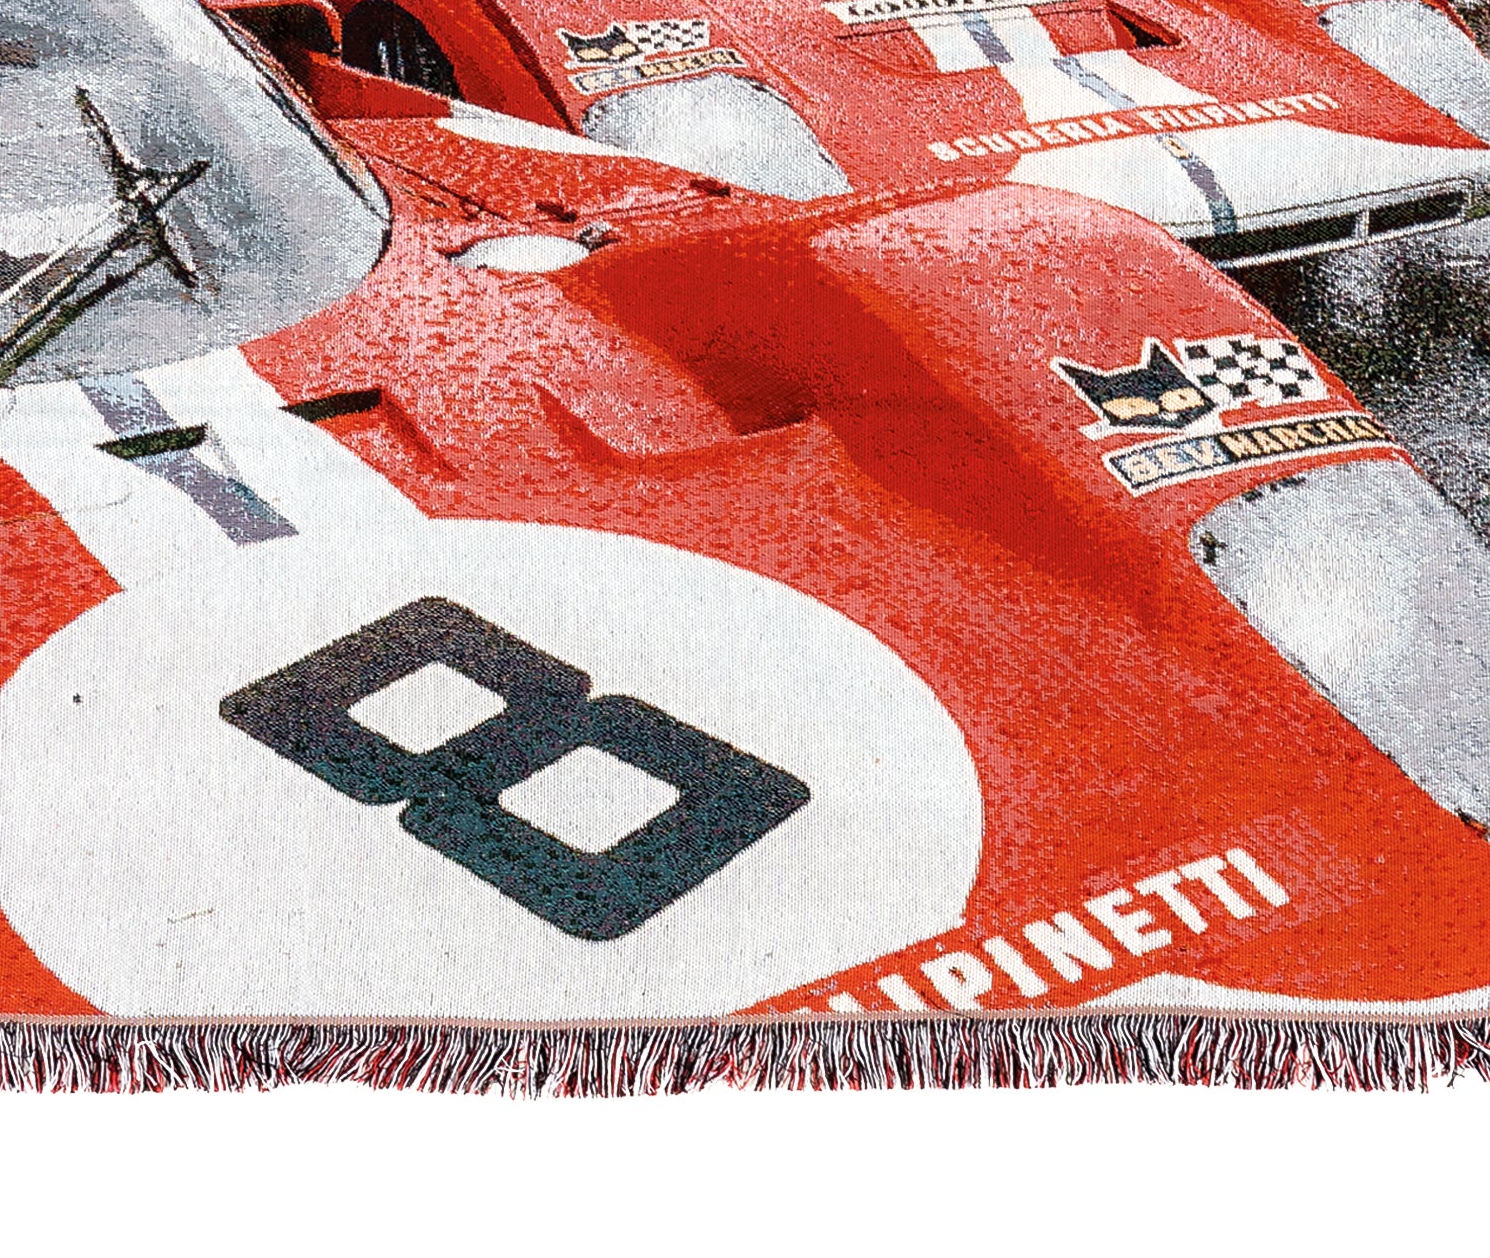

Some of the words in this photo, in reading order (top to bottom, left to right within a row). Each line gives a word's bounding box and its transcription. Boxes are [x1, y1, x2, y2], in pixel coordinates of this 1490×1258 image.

[926, 110, 1135, 163] SCUDERIA
[1145, 91, 1342, 132] FILIPINETTI
[218, 595, 811, 943] 8
